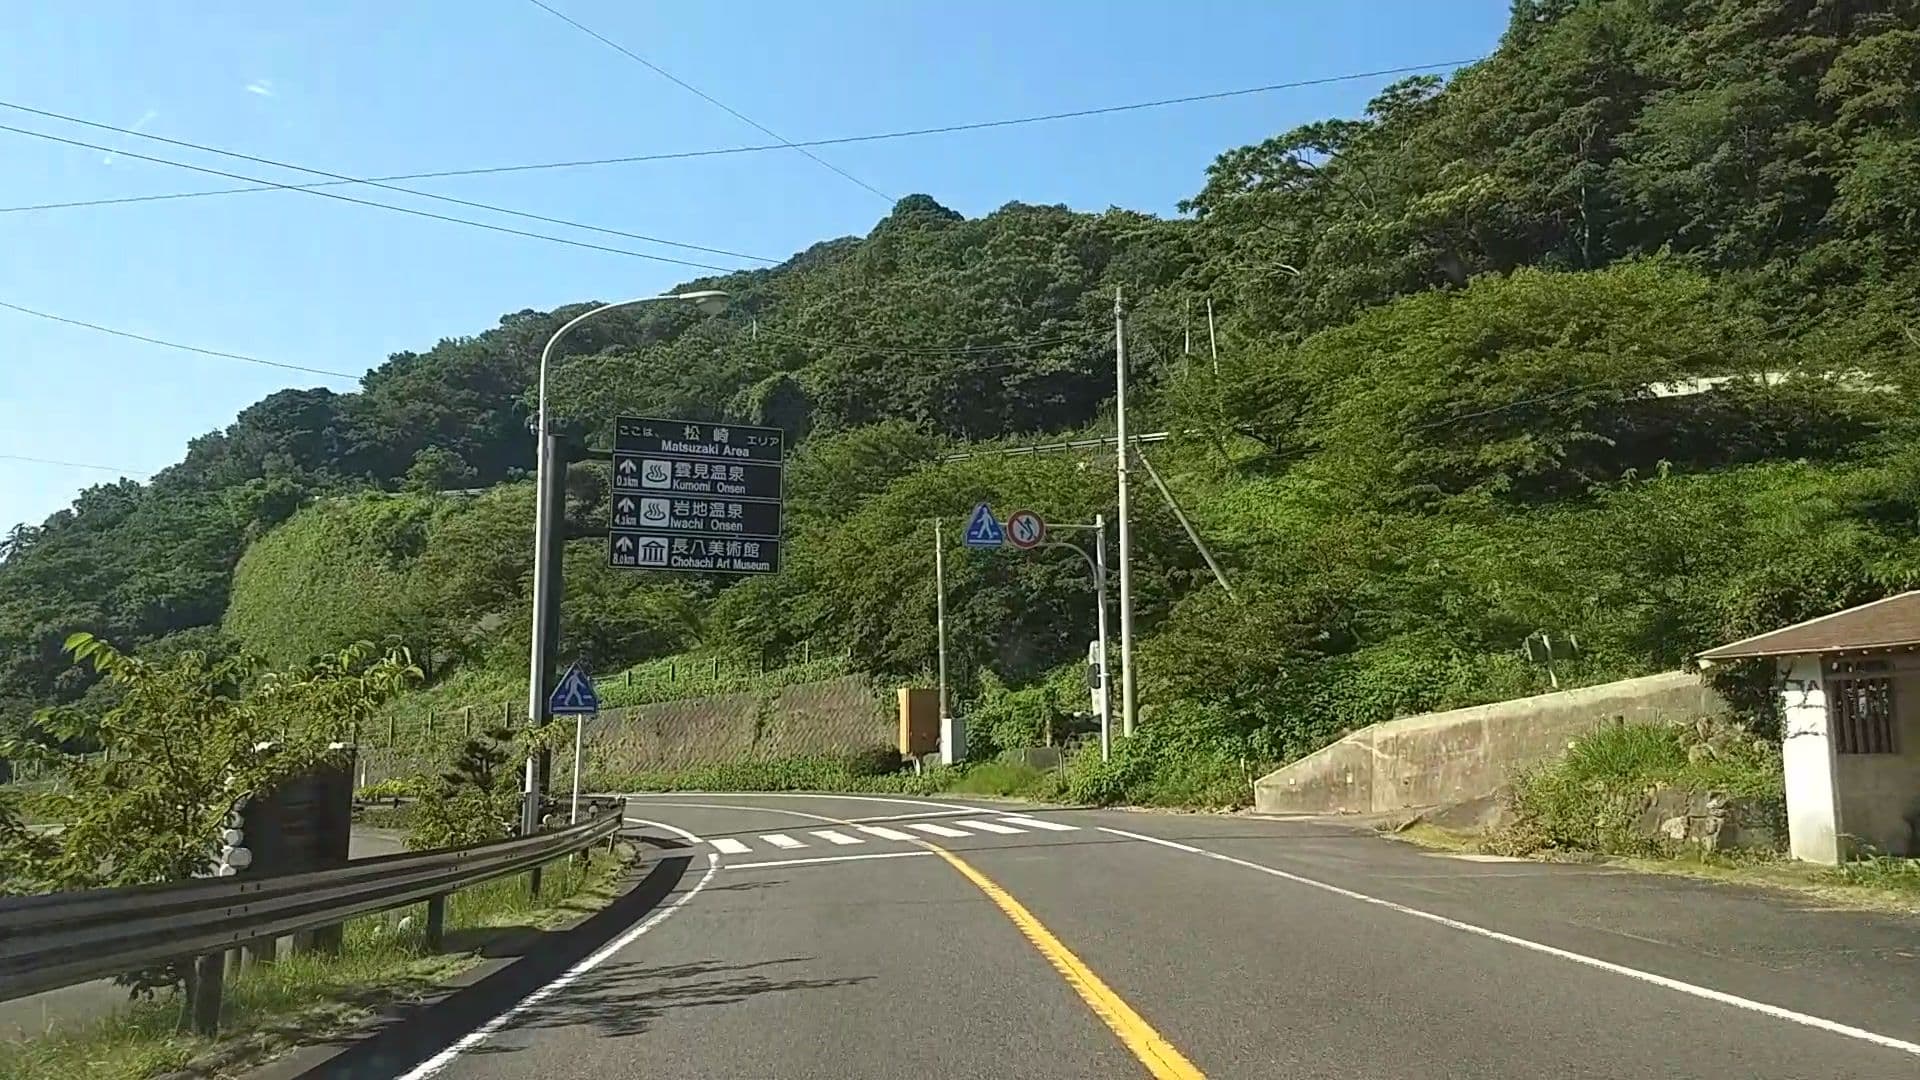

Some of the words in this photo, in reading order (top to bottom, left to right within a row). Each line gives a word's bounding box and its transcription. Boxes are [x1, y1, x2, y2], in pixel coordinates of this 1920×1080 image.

[661, 440, 719, 454] Matsuzaki
[723, 445, 749, 457] Area
[747, 436, 779, 446] エリア
[675, 462, 744, 481] 雲見温泉
[673, 480, 711, 491] Kumomi
[717, 482, 745, 494] Onsen
[673, 500, 743, 518] 岩地温泉
[670, 517, 703, 529] Iwachi
[711, 519, 743, 531] Onsen
[672, 539, 759, 557] 長八美術館
[671, 556, 713, 567] Chohachi
[716, 559, 730, 569] Art
[733, 560, 769, 570] Museum
